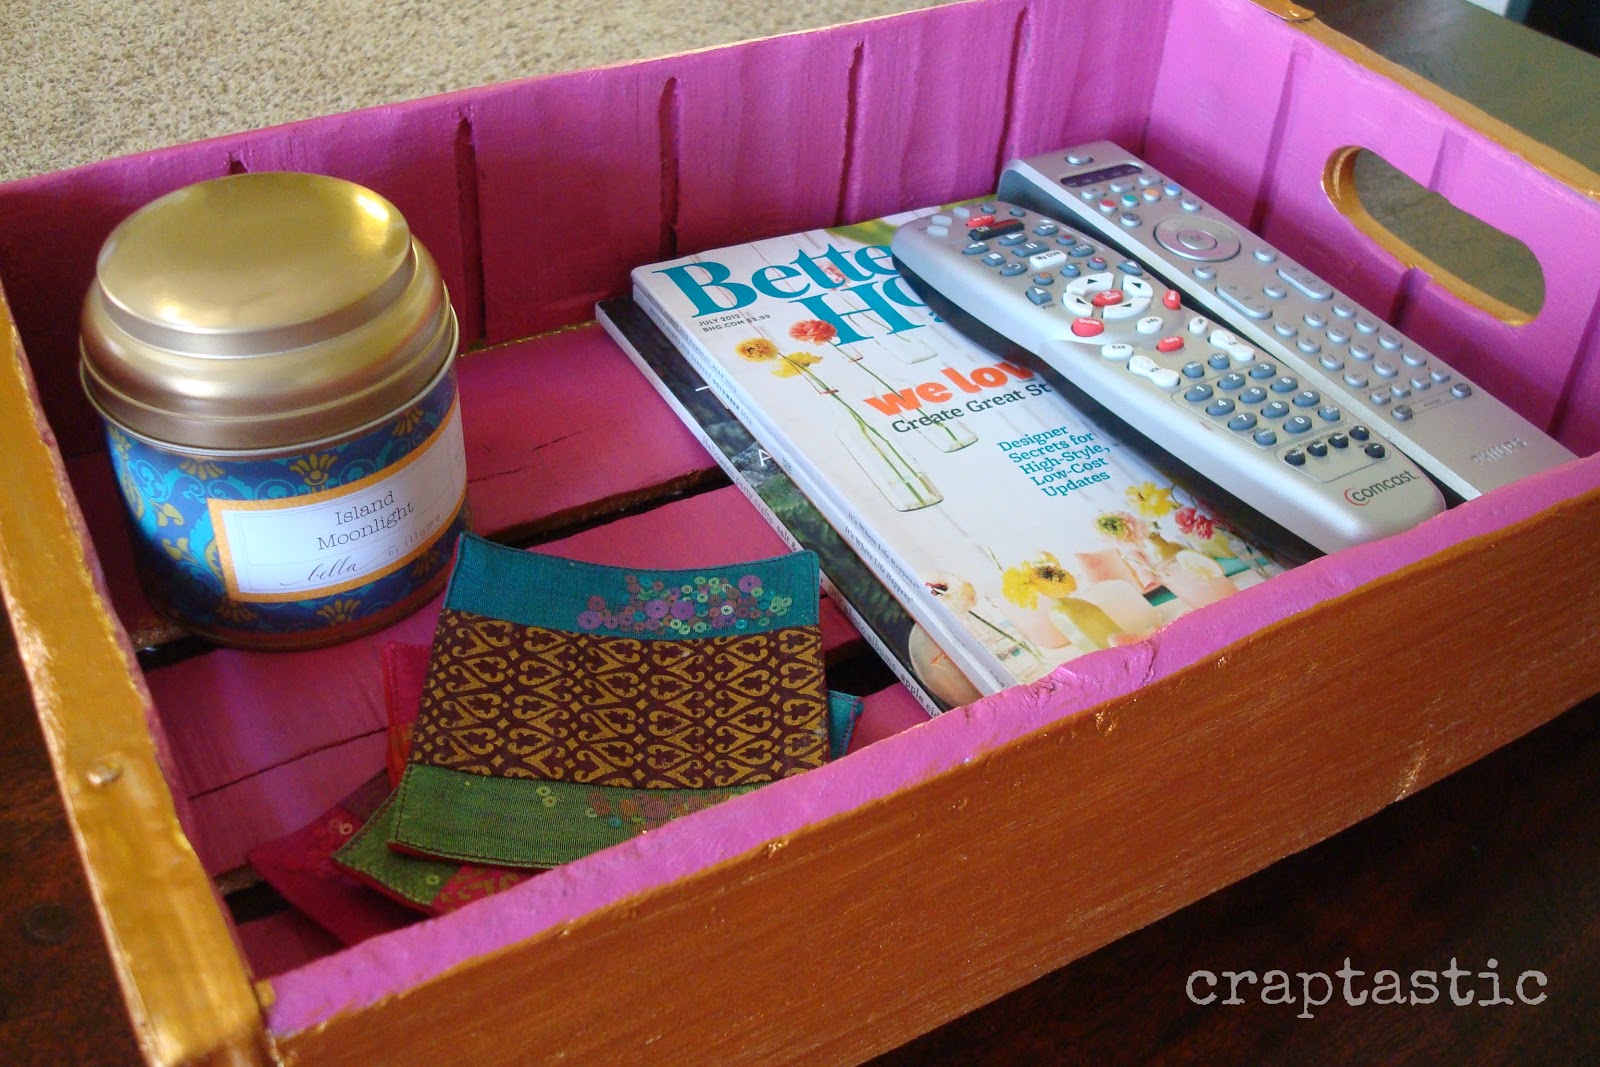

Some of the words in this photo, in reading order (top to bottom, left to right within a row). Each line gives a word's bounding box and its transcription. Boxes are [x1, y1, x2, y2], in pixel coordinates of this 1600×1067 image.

[651, 243, 893, 318] Bette
[698, 319, 718, 327] JULY
[719, 313, 742, 323] 2012
[702, 320, 745, 333] BHG.COM
[746, 314, 771, 324] $3.99
[1078, 318, 1100, 326] Guide
[1229, 373, 1239, 381] 2
[863, 381, 953, 416] we
[1250, 387, 1261, 395] 5
[892, 408, 965, 433] Create
[966, 388, 1026, 413] Great
[1238, 414, 1248, 422] 7
[1272, 402, 1282, 410] 8
[1295, 416, 1305, 424] 0
[997, 425, 1069, 452] Designer
[1008, 440, 1070, 463] Secrets
[1069, 432, 1095, 446] for
[1018, 444, 1111, 475] High-Style,
[1030, 457, 1109, 486] Low-Cost
[697, 435, 739, 478] Halloween
[732, 477, 755, 500] party
[751, 498, 776, 524] crafts
[774, 525, 792, 543] salt
[1041, 471, 1111, 497] Updates
[335, 490, 395, 526] Island
[316, 501, 414, 550] Moonlight
[857, 523, 878, 545] Where
[308, 555, 358, 582] bella
[853, 537, 874, 559] Where
[872, 558, 886, 573] Life
[864, 633, 901, 670] albums
[897, 672, 927, 703] apple
